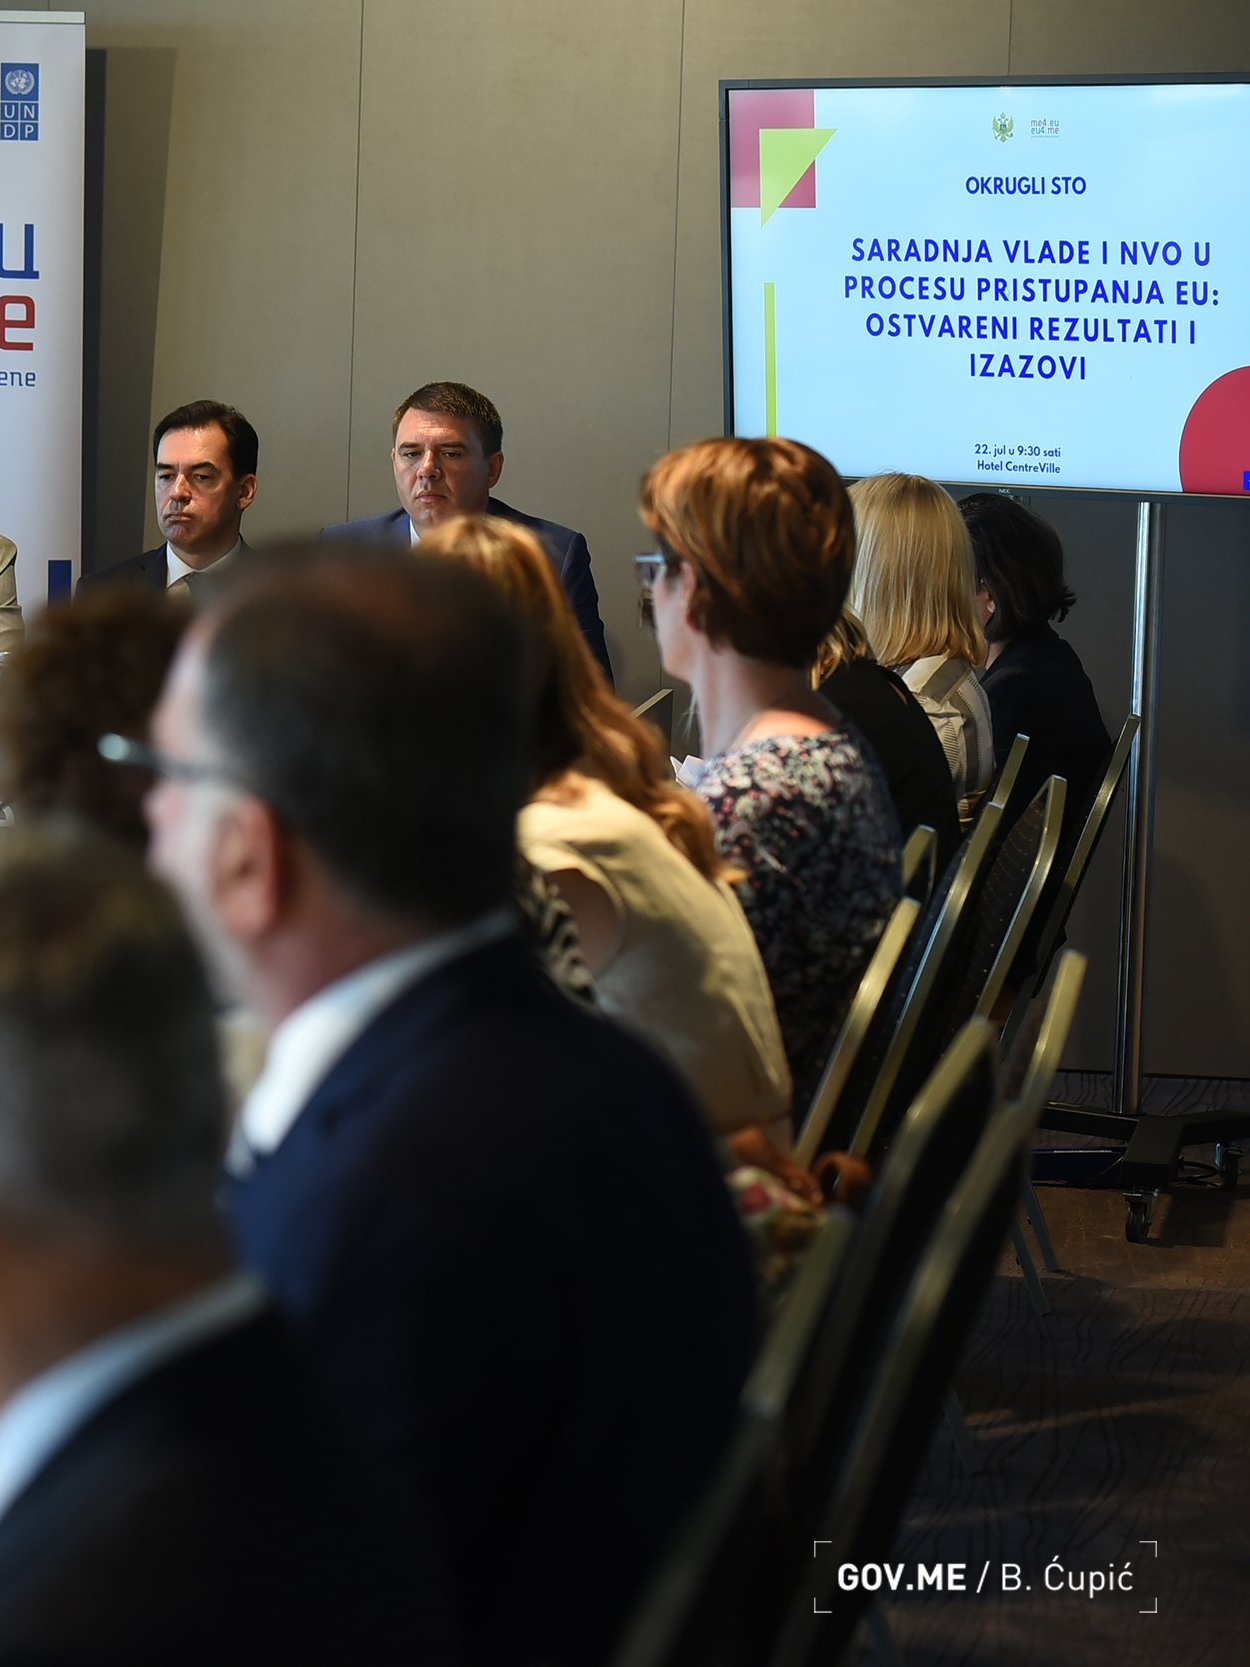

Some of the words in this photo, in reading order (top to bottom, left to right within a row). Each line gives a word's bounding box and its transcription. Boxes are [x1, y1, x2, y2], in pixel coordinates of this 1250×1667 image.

[966, 177, 1045, 194] OKRUGLI
[1051, 177, 1086, 194] STO
[852, 238, 992, 262] SARADNJA
[1003, 240, 1089, 264] VLADE
[1102, 240, 1108, 265] I
[1121, 241, 1181, 265] NVO
[1195, 242, 1210, 266] U
[845, 276, 964, 300] PROCESU
[978, 278, 1164, 304] PRISTUPANJA
[1177, 281, 1218, 305] EU:
[866, 313, 1017, 339] OSTVARENI
[1030, 317, 1176, 343] REZULTATI
[1189, 320, 1195, 345] I
[971, 354, 1085, 379] IZAZOVI
[974, 443, 992, 455] 22.
[993, 443, 1006, 458] jul
[1008, 448, 1015, 456] u
[1017, 445, 1041, 457] 9:30
[1043, 447, 1061, 458] sati
[977, 459, 1003, 472] Hotel
[1005, 460, 1061, 474] CentreVille
